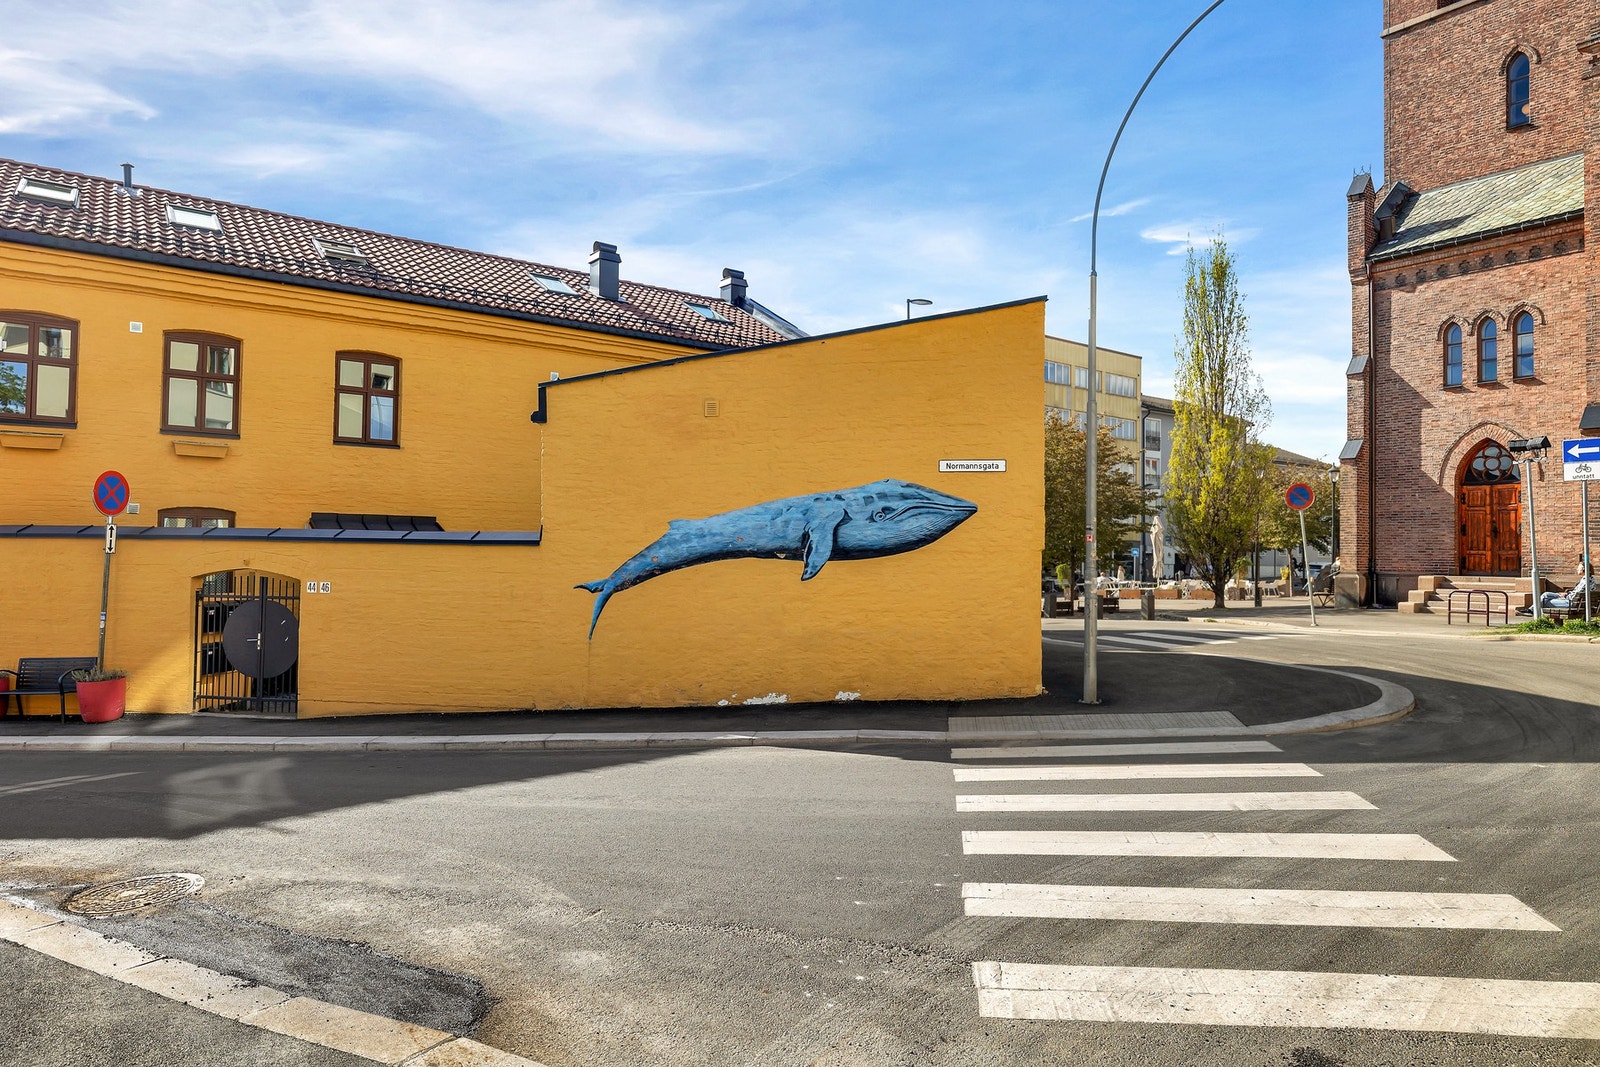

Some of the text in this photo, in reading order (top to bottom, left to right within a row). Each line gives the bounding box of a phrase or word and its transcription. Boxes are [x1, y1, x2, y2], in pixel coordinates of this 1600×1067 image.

[946, 463, 999, 471] Normannsgata
[308, 582, 330, 593] 44 46
